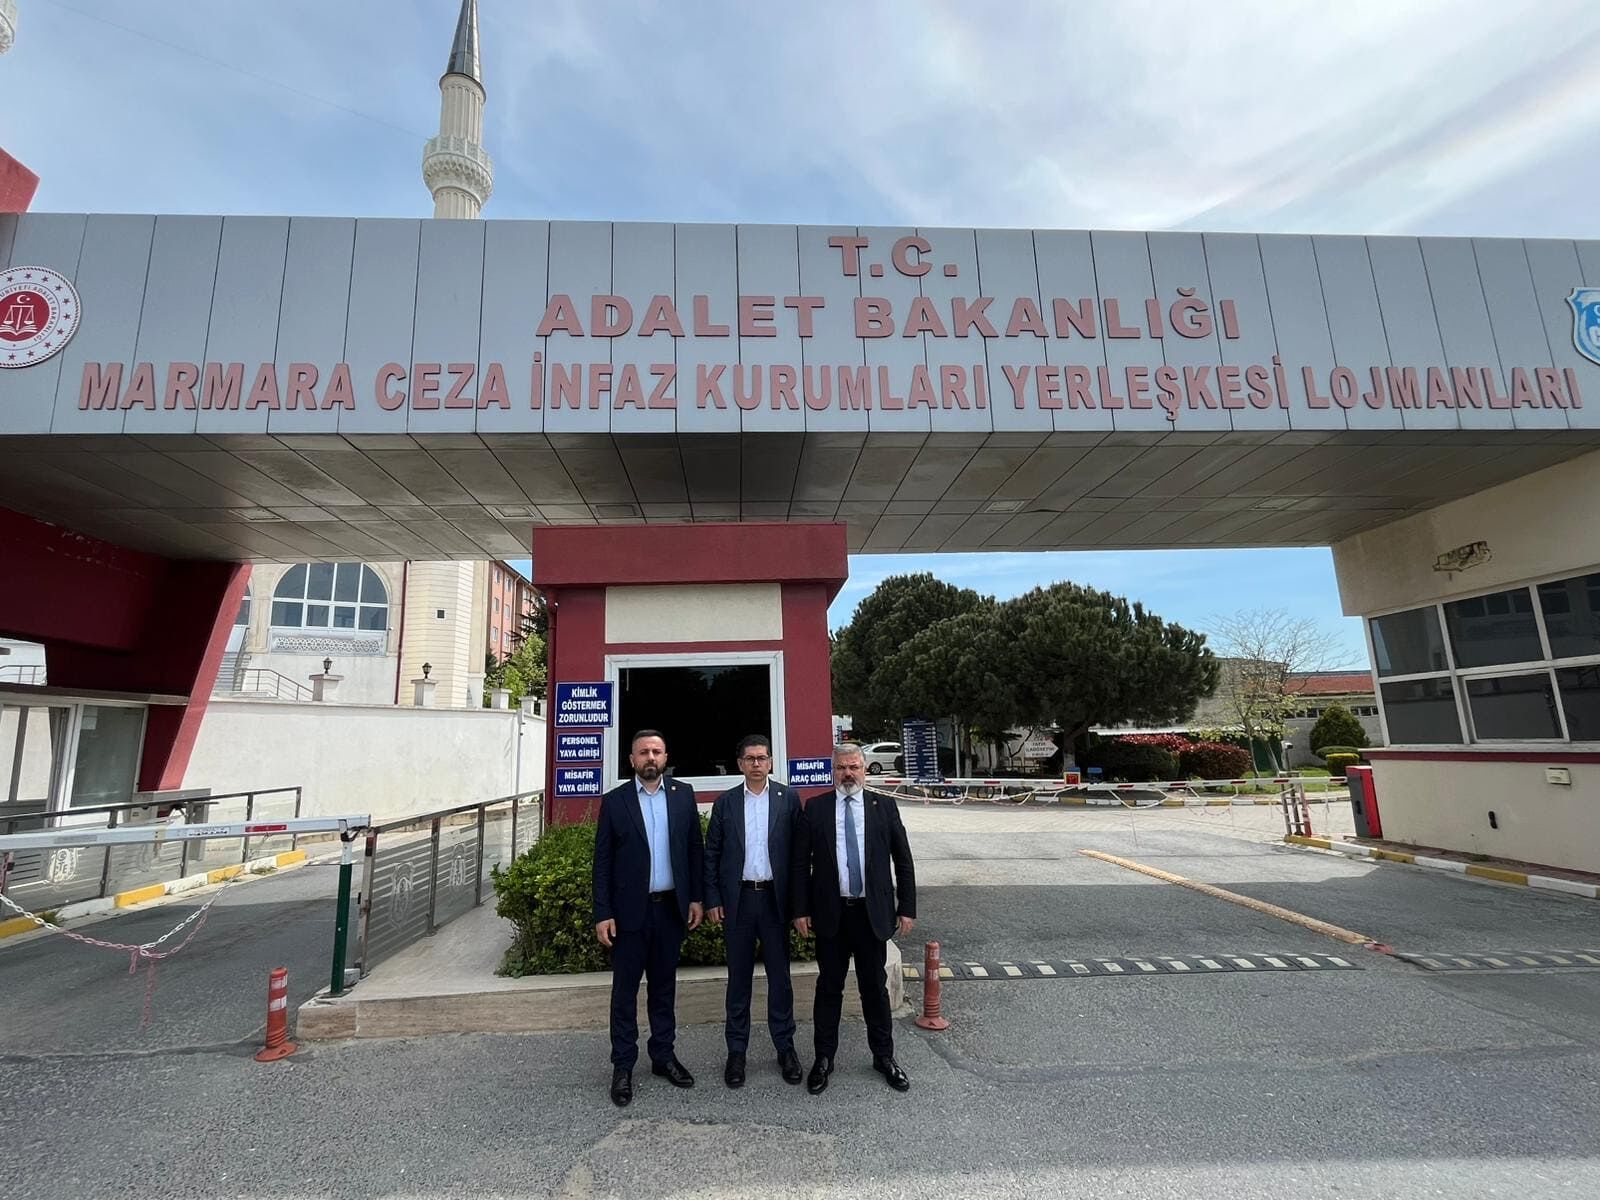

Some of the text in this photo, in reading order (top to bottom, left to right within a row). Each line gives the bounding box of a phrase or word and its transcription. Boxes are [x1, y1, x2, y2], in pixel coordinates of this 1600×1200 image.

[829, 236, 957, 277] T.C.
[536, 287, 1240, 339] ADALET BAKANLIĞI
[78, 351, 1582, 420] MARMARA CEZA İNFAZ KURUMLARI YERLEŞKESİ LOJMANLARI
[571, 686, 597, 698] KİMLİK
[561, 699, 607, 710] GÖSTERMEK
[559, 713, 608, 723] ZORUNLUDUR
[562, 736, 598, 745] PERSONEL
[560, 747, 600, 759] YAYA GİRİŞİ
[797, 760, 824, 770] MİSAFİR
[564, 769, 594, 780] MİSAFİR
[791, 772, 831, 784] ARAÇ GİRİŞİ
[558, 781, 599, 794] YAYA GİRİŞİ
